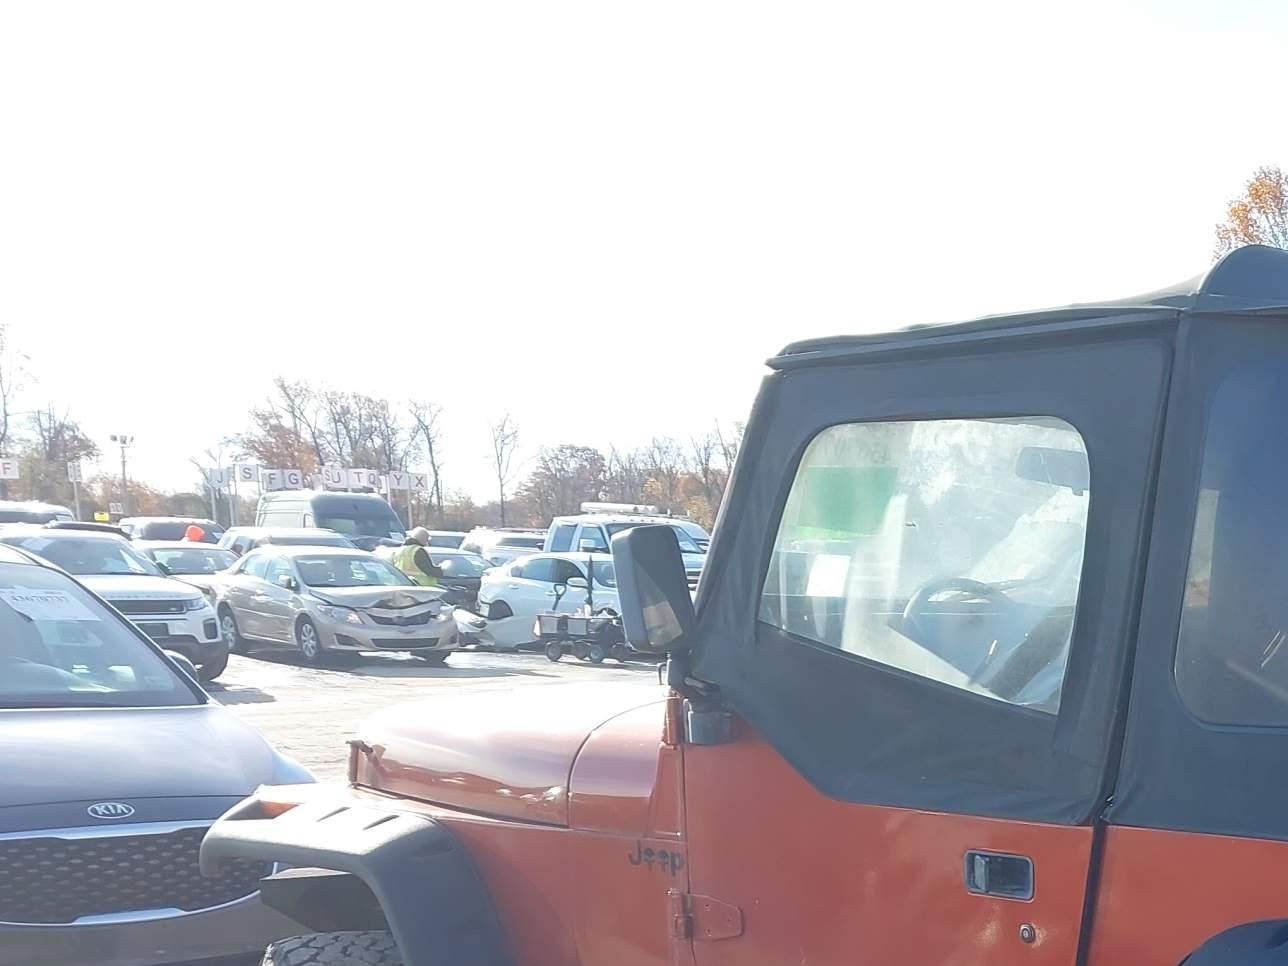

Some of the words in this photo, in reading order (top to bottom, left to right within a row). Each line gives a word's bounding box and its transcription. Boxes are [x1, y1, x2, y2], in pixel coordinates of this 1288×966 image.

[242, 466, 253, 480] S
[268, 472, 278, 485] F
[287, 472, 300, 485] G
[332, 471, 342, 484] U
[353, 471, 363, 483] T
[368, 472, 378, 485] Q
[393, 474, 404, 486] Y
[415, 475, 425, 488] X
[94, 804, 129, 816] KIA
[628, 840, 686, 877] Jeep
